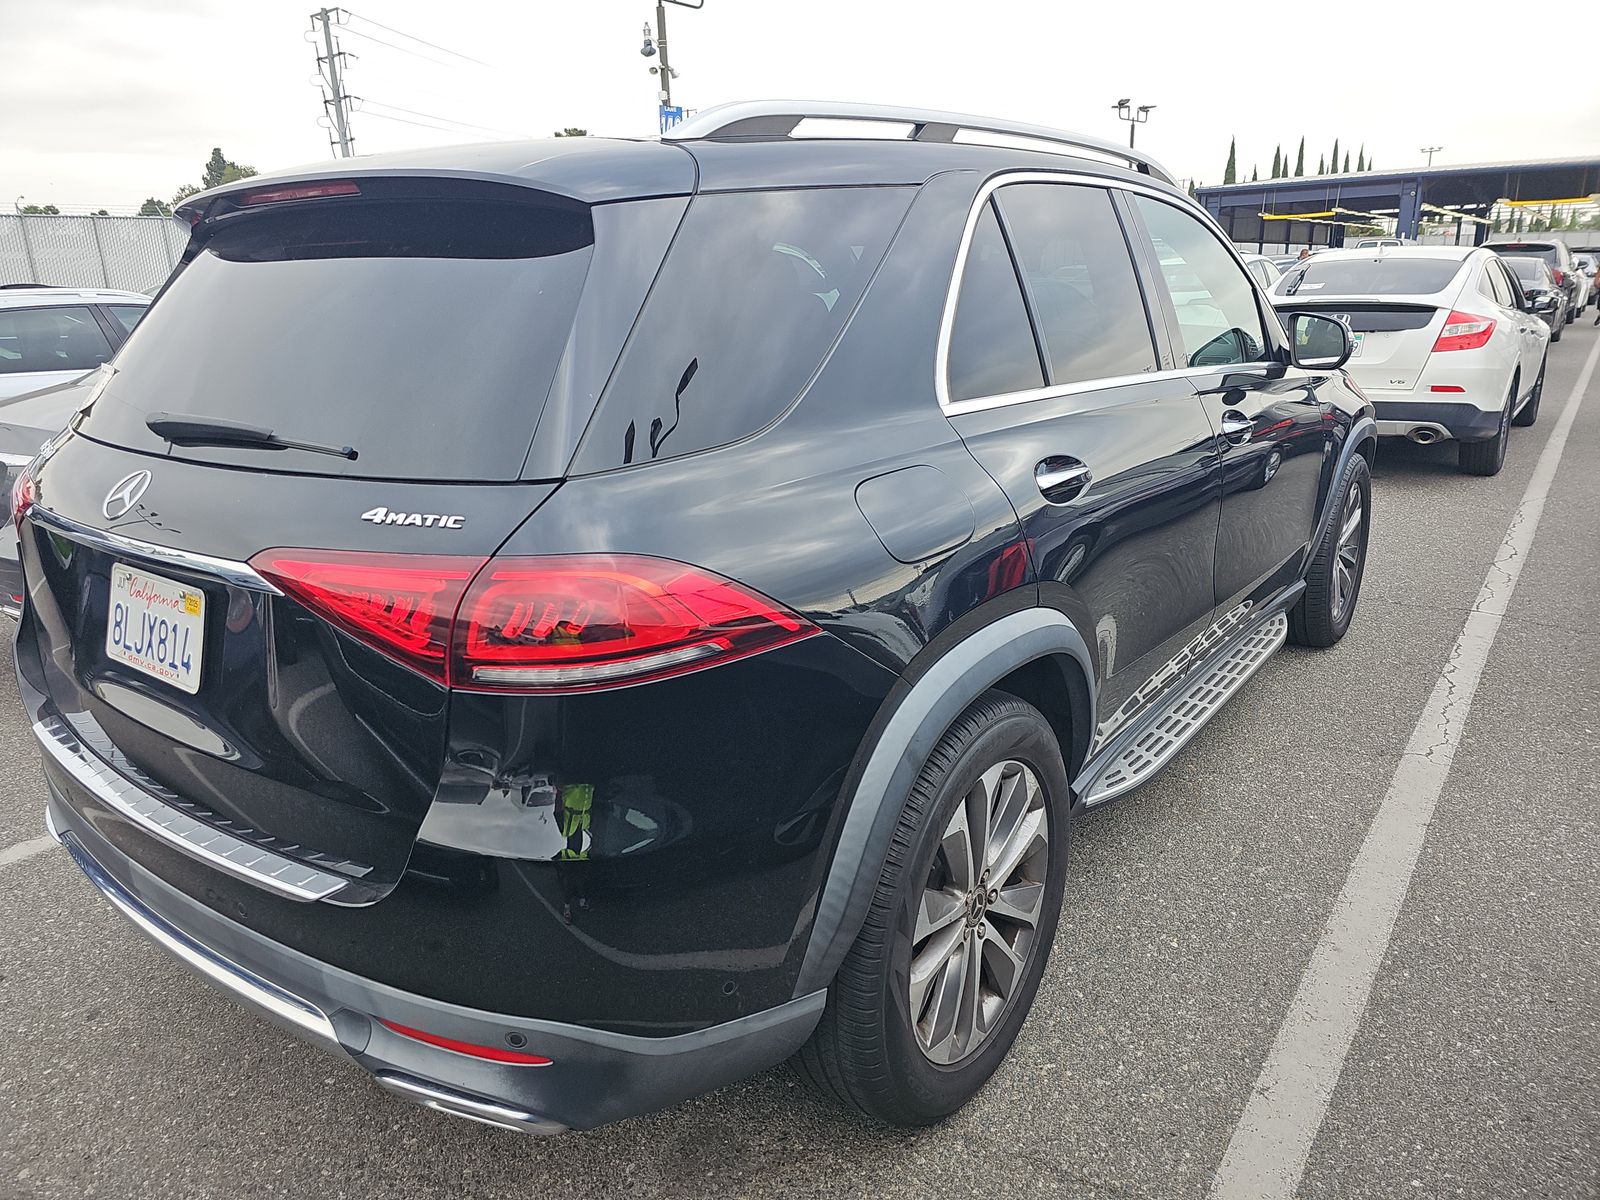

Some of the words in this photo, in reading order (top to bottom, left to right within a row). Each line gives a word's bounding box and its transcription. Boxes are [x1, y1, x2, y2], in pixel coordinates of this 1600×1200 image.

[360, 506, 466, 529] 4MATIC
[129, 576, 180, 609] California
[113, 602, 192, 675] 8LJX814
[128, 654, 175, 678] dmv.ca.gov
